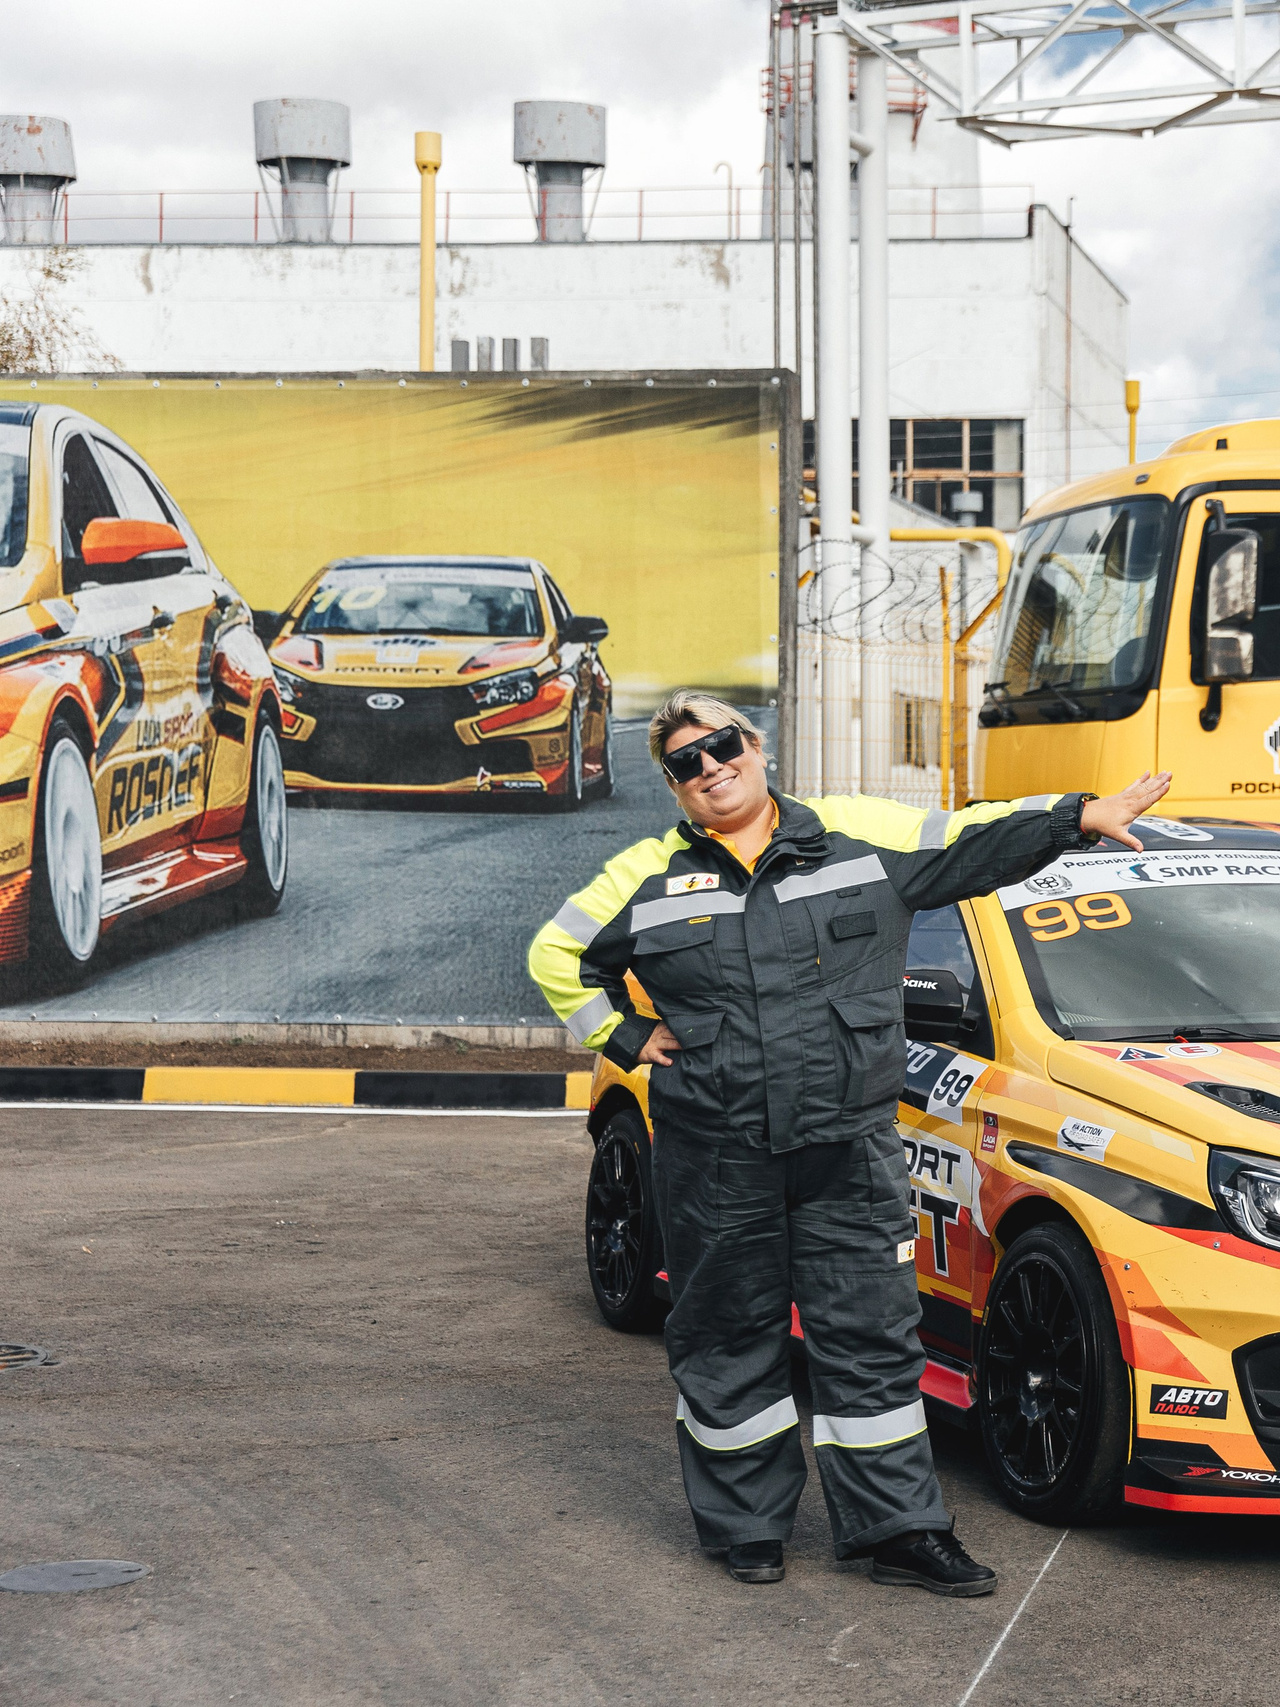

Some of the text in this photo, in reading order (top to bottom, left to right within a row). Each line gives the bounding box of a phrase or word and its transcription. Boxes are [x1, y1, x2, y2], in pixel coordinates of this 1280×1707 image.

[313, 586, 387, 614] 10
[1063, 855, 1160, 868] Российская
[1164, 853, 1210, 861] серия
[1159, 865, 1219, 878] SMP
[1022, 892, 1132, 942] 99
[906, 1038, 938, 1074] ТО
[933, 1068, 974, 1107] 99
[983, 1134, 996, 1144] LADA
[1080, 1125, 1103, 1136] ACTION
[901, 1136, 962, 1188] ORT
[1159, 1387, 1224, 1406] АВТО
[1154, 1402, 1200, 1415] ПЛЮС
